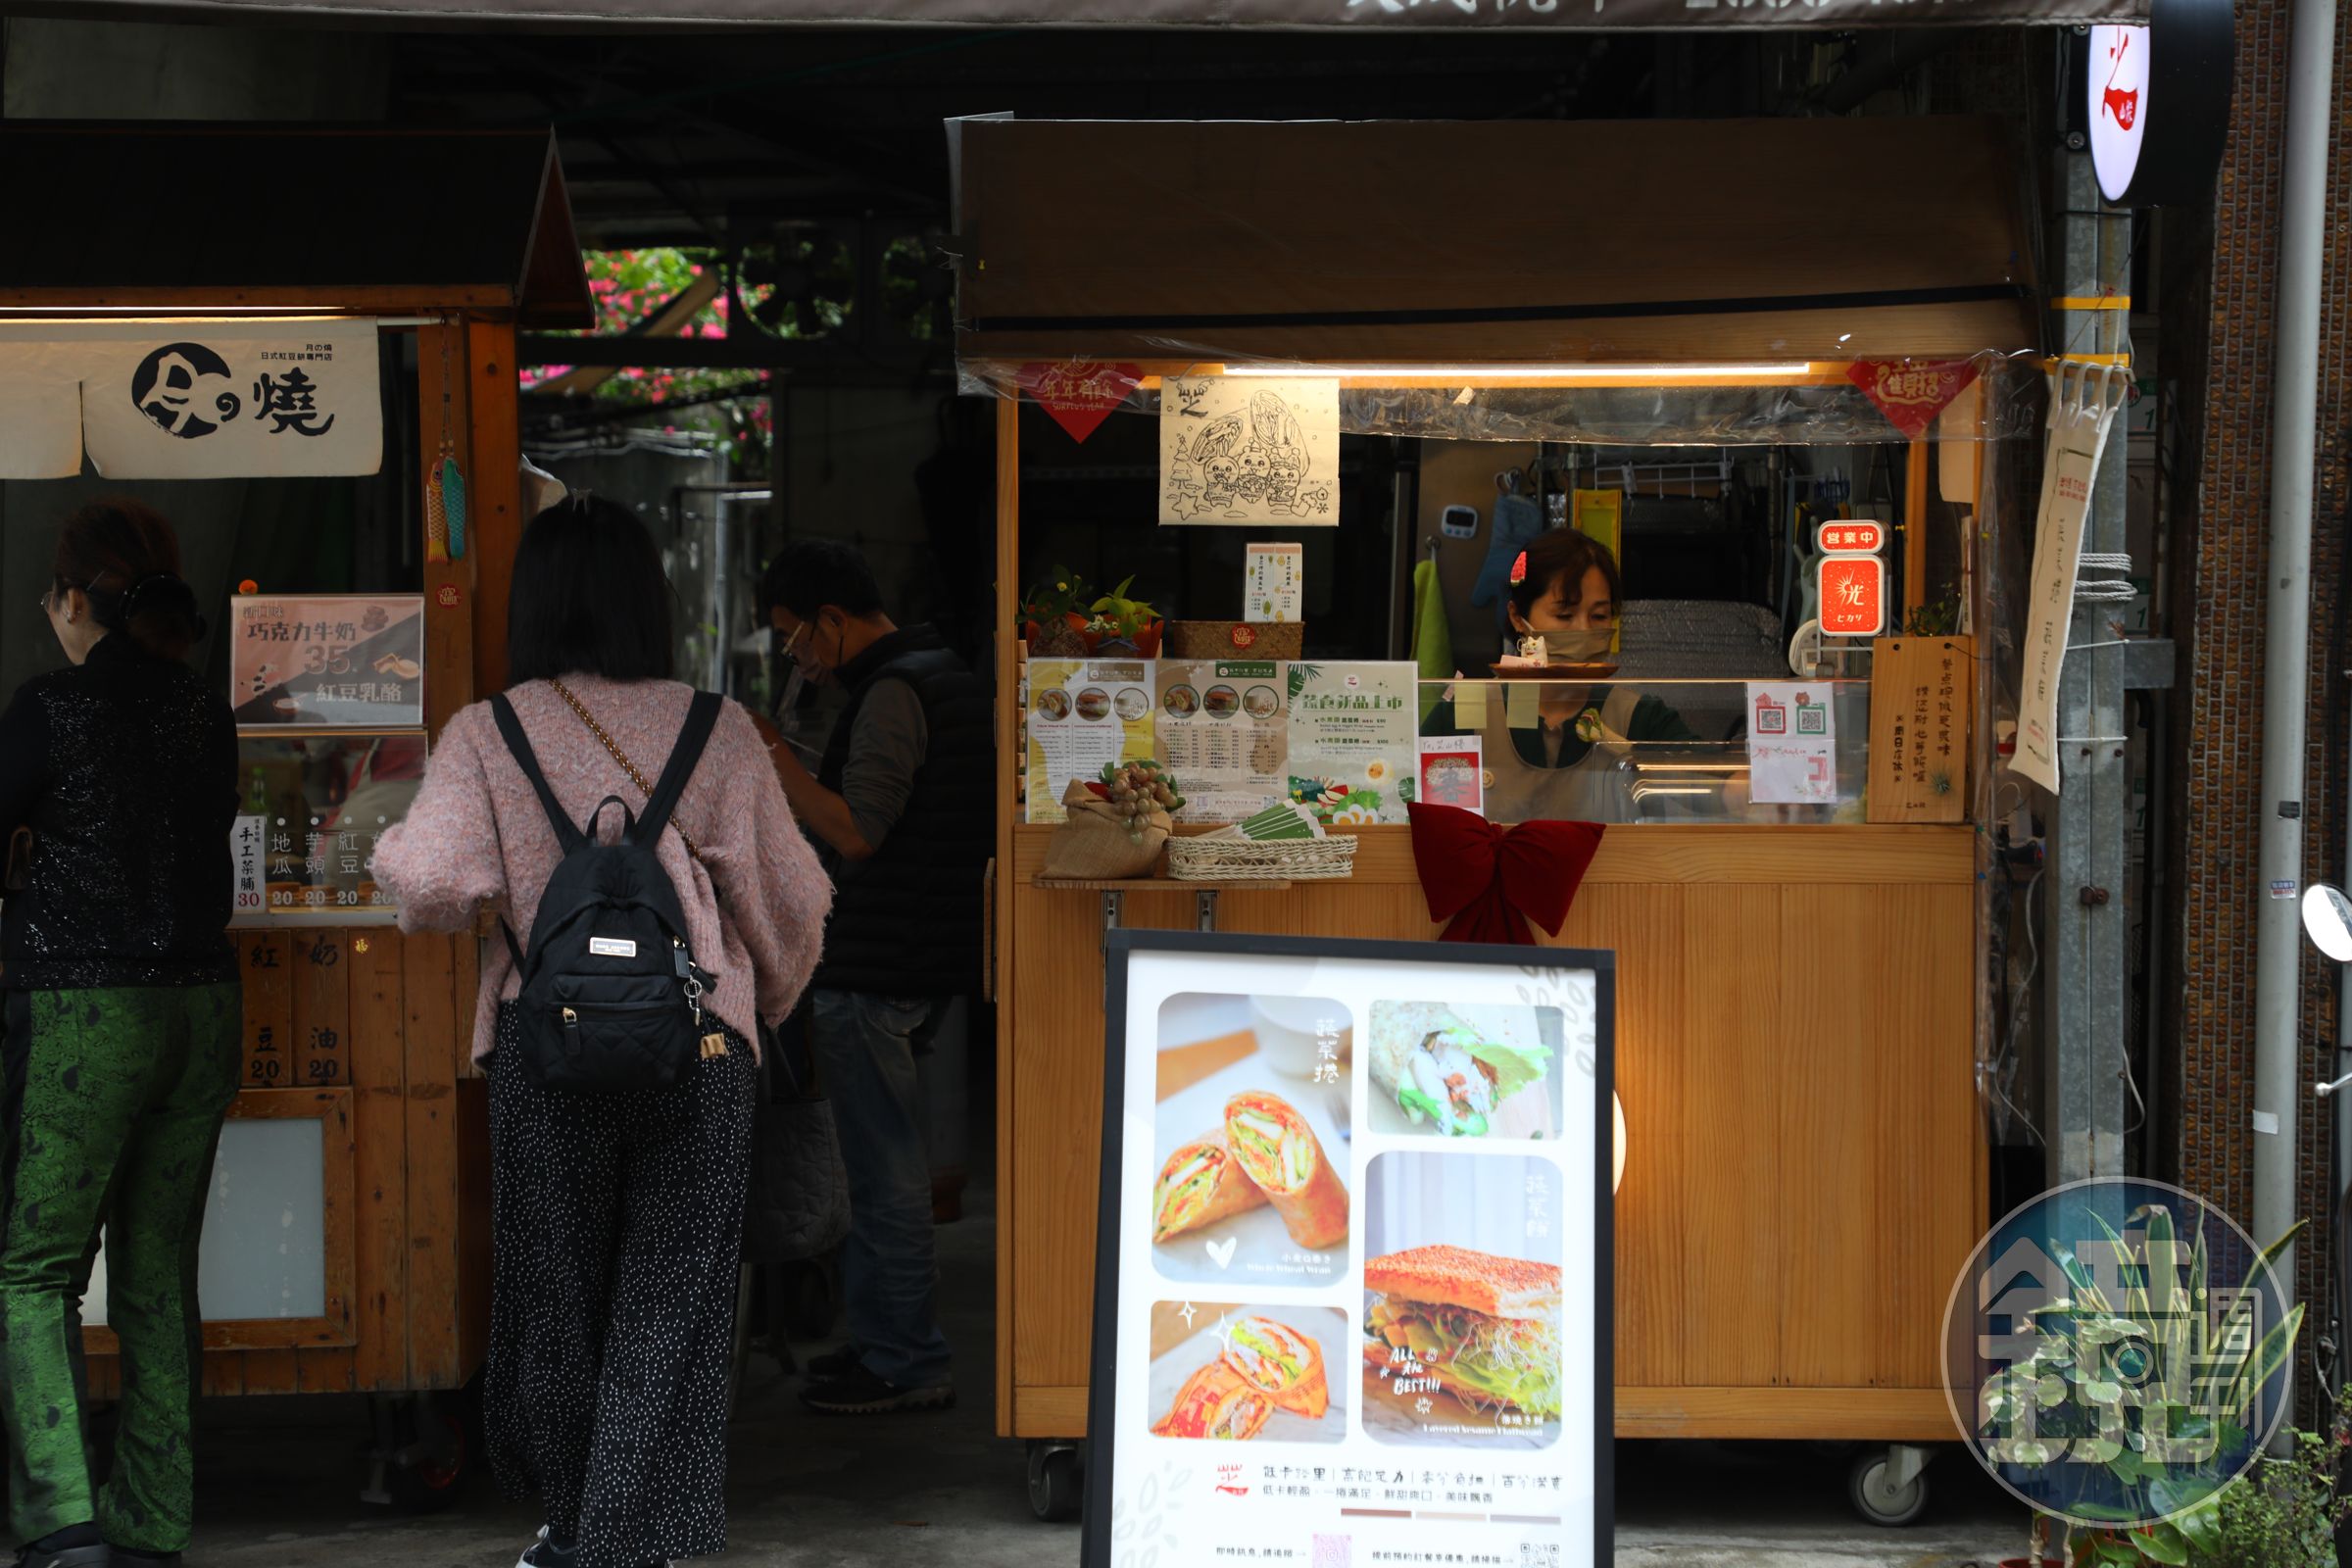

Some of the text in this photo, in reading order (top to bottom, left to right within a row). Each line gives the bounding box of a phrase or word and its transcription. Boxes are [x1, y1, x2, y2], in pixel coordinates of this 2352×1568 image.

[1827, 532, 1874, 544] 営業中
[247, 621, 357, 642] 巧克力牛奶
[304, 645, 350, 674] 35
[316, 682, 402, 703] 紅豆乳酪
[271, 833, 292, 874] 地瓜
[305, 832, 325, 874] 芋頭
[338, 832, 359, 873] 紅豆
[238, 893, 260, 907] 30
[272, 891, 293, 906] 20
[305, 891, 325, 905] 20
[337, 890, 358, 905] 20
[251, 1059, 279, 1079] 20
[310, 1059, 338, 1078] 20
[1390, 1348, 1416, 1363] ALL
[1394, 1378, 1441, 1396] BEST!!!
